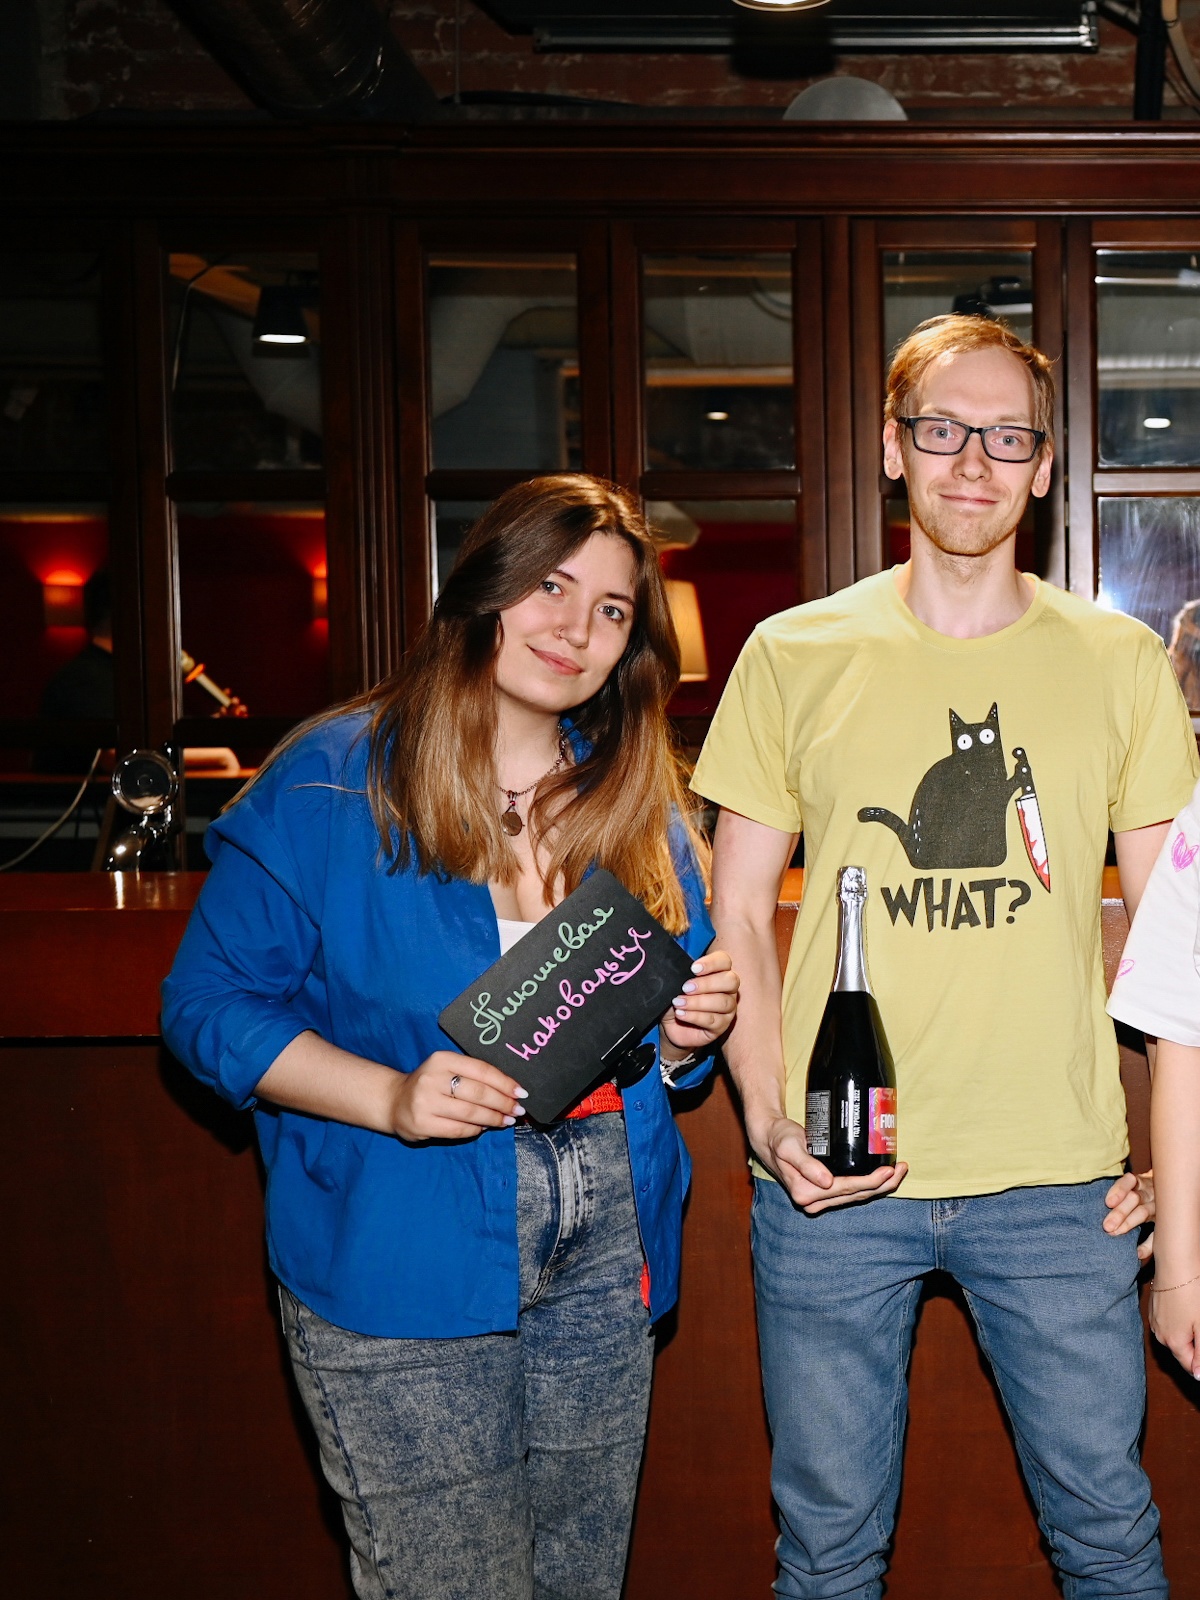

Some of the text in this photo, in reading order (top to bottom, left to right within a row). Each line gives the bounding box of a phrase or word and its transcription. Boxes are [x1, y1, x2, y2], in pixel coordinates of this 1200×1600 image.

[880, 876, 1032, 933] WHAT?
[469, 905, 615, 1046] Плюшевая
[505, 926, 653, 1062] наковальня
